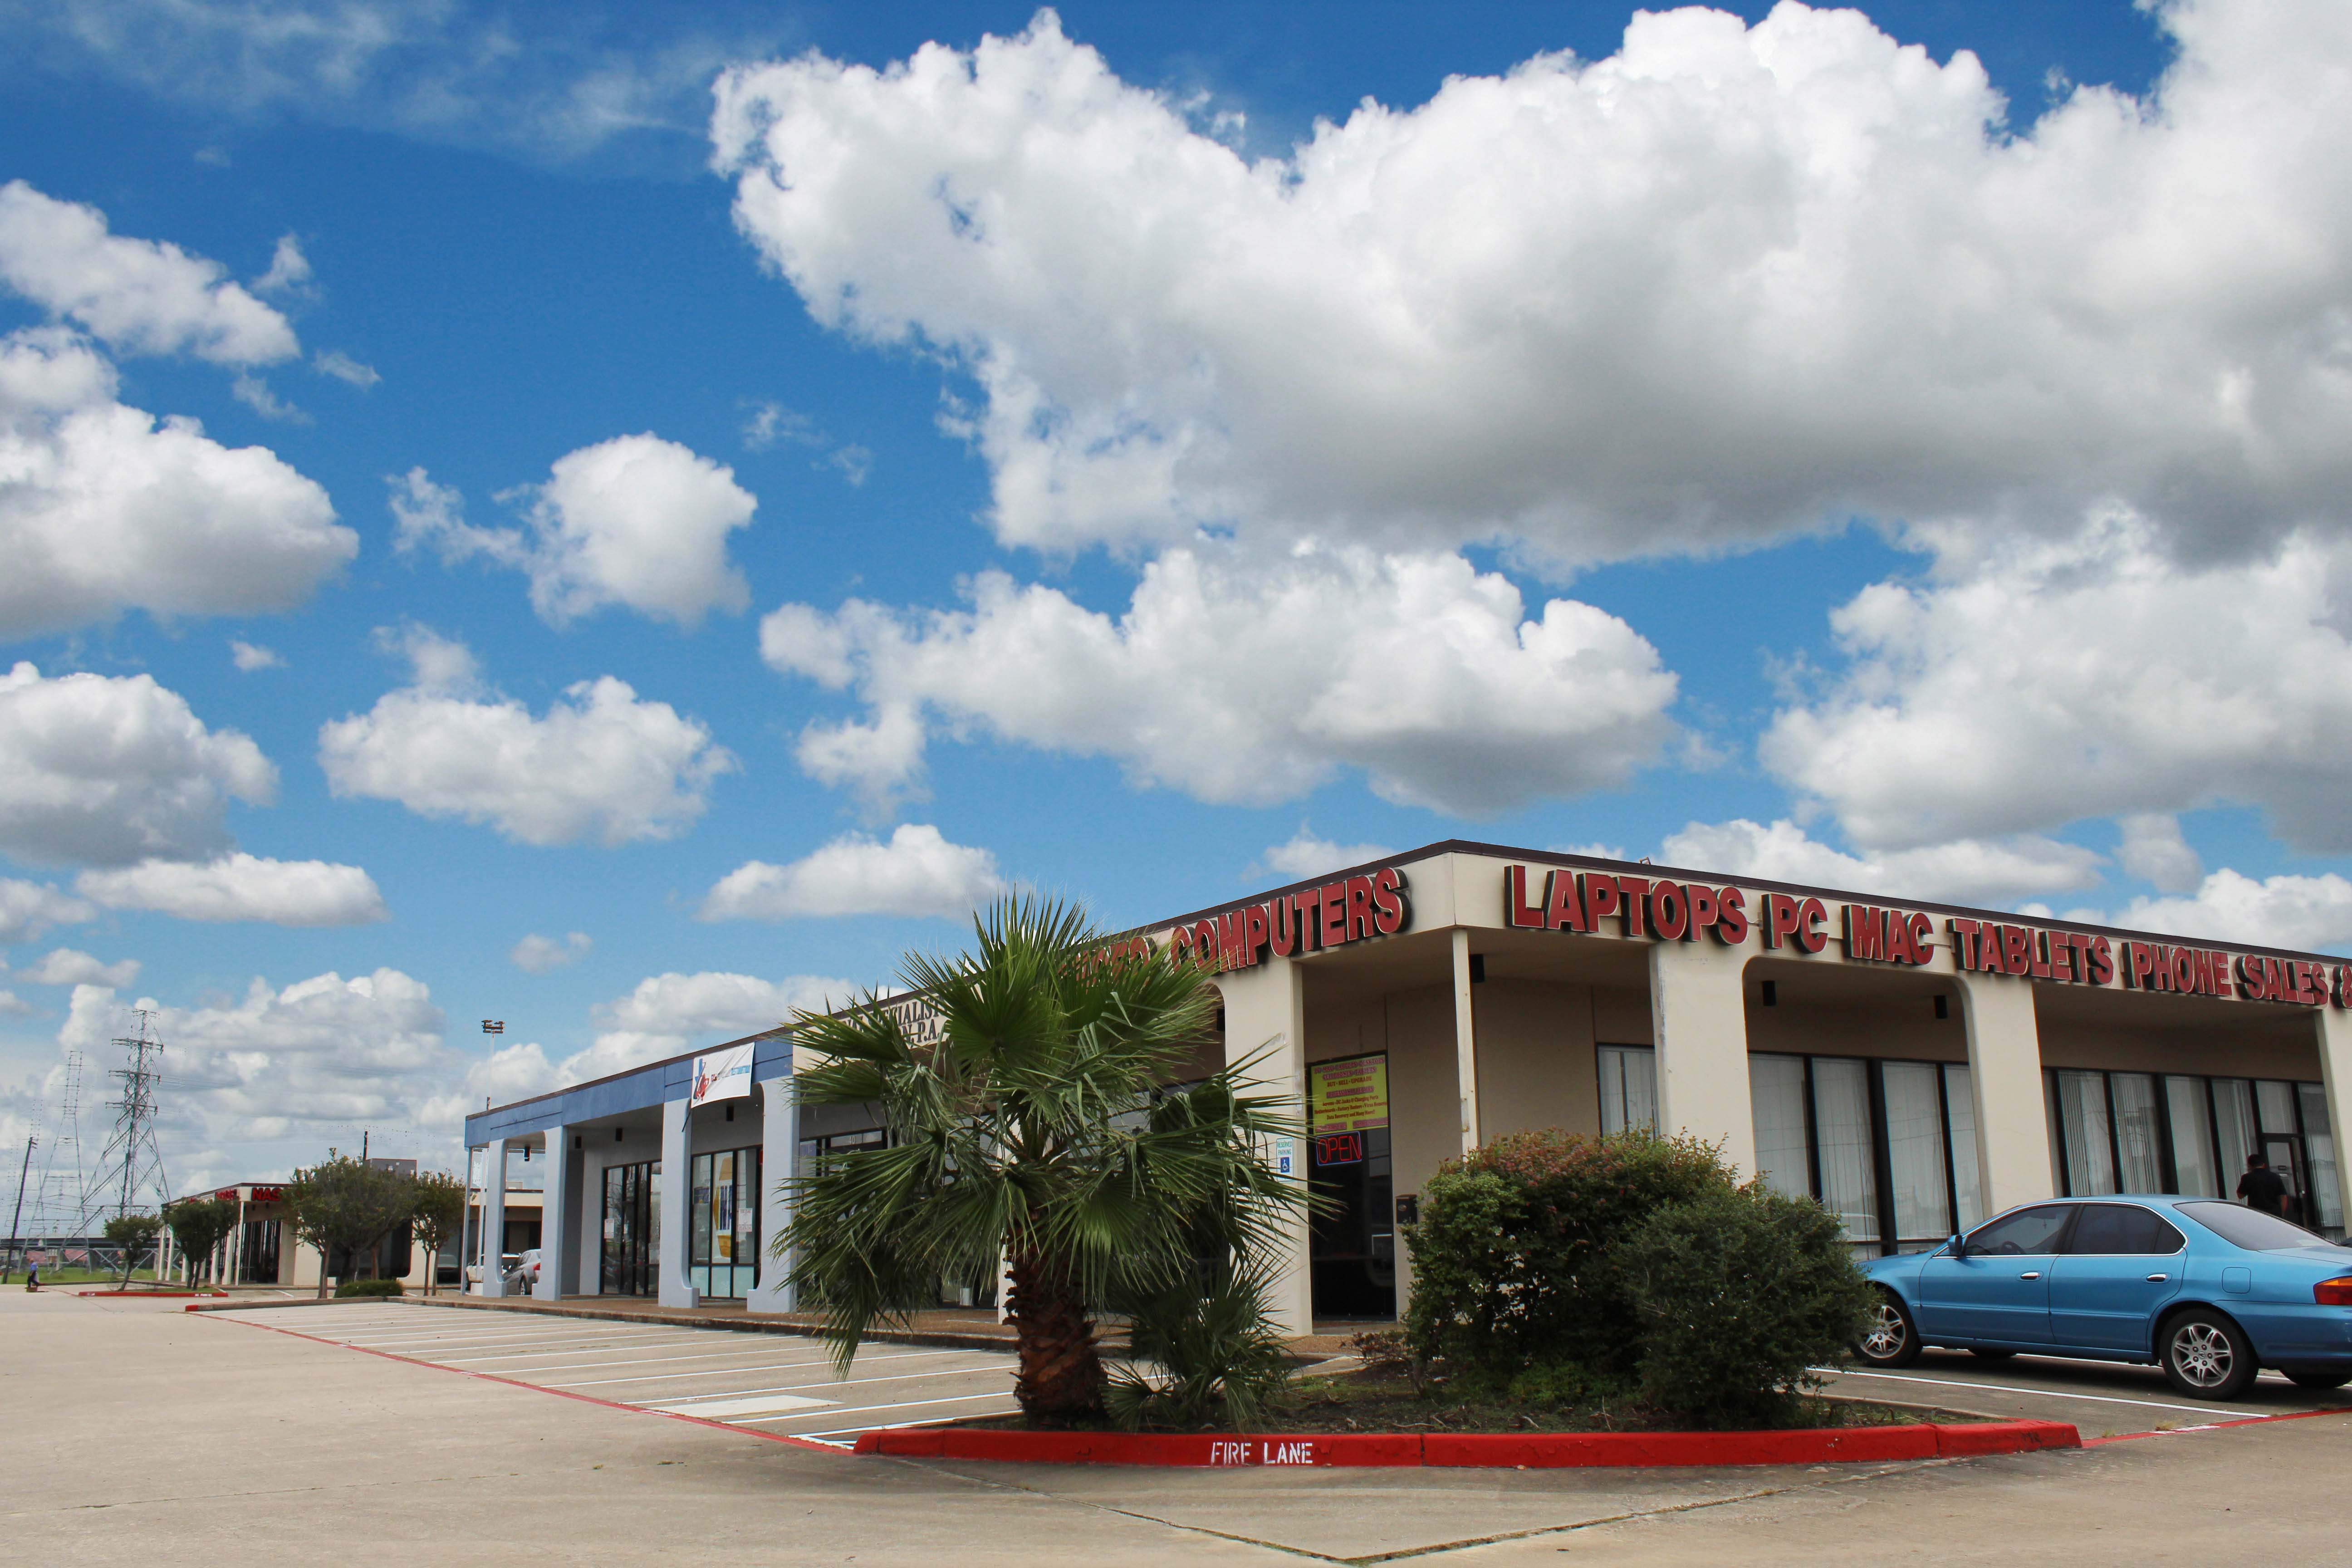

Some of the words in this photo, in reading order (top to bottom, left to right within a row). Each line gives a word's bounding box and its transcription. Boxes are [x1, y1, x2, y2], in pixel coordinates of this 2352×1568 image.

[1171, 867, 1409, 973] COMPUTERS
[1504, 865, 1748, 945] LAPTOPS
[1762, 893, 1828, 953] PC
[1842, 904, 1935, 965] MAC
[1946, 918, 2114, 984] TABLETS
[2122, 941, 2232, 996] PHONE
[2235, 955, 2328, 1005] SALES
[917, 1019, 940, 1043] P.A.
[1360, 1058, 1385, 1067] DESKTOPS
[1351, 1076, 1372, 1084] UPGRADE
[1318, 1135, 1362, 1164] OPEN
[1210, 1441, 1252, 1465] FIRE
[1264, 1442, 1313, 1464] LANE
